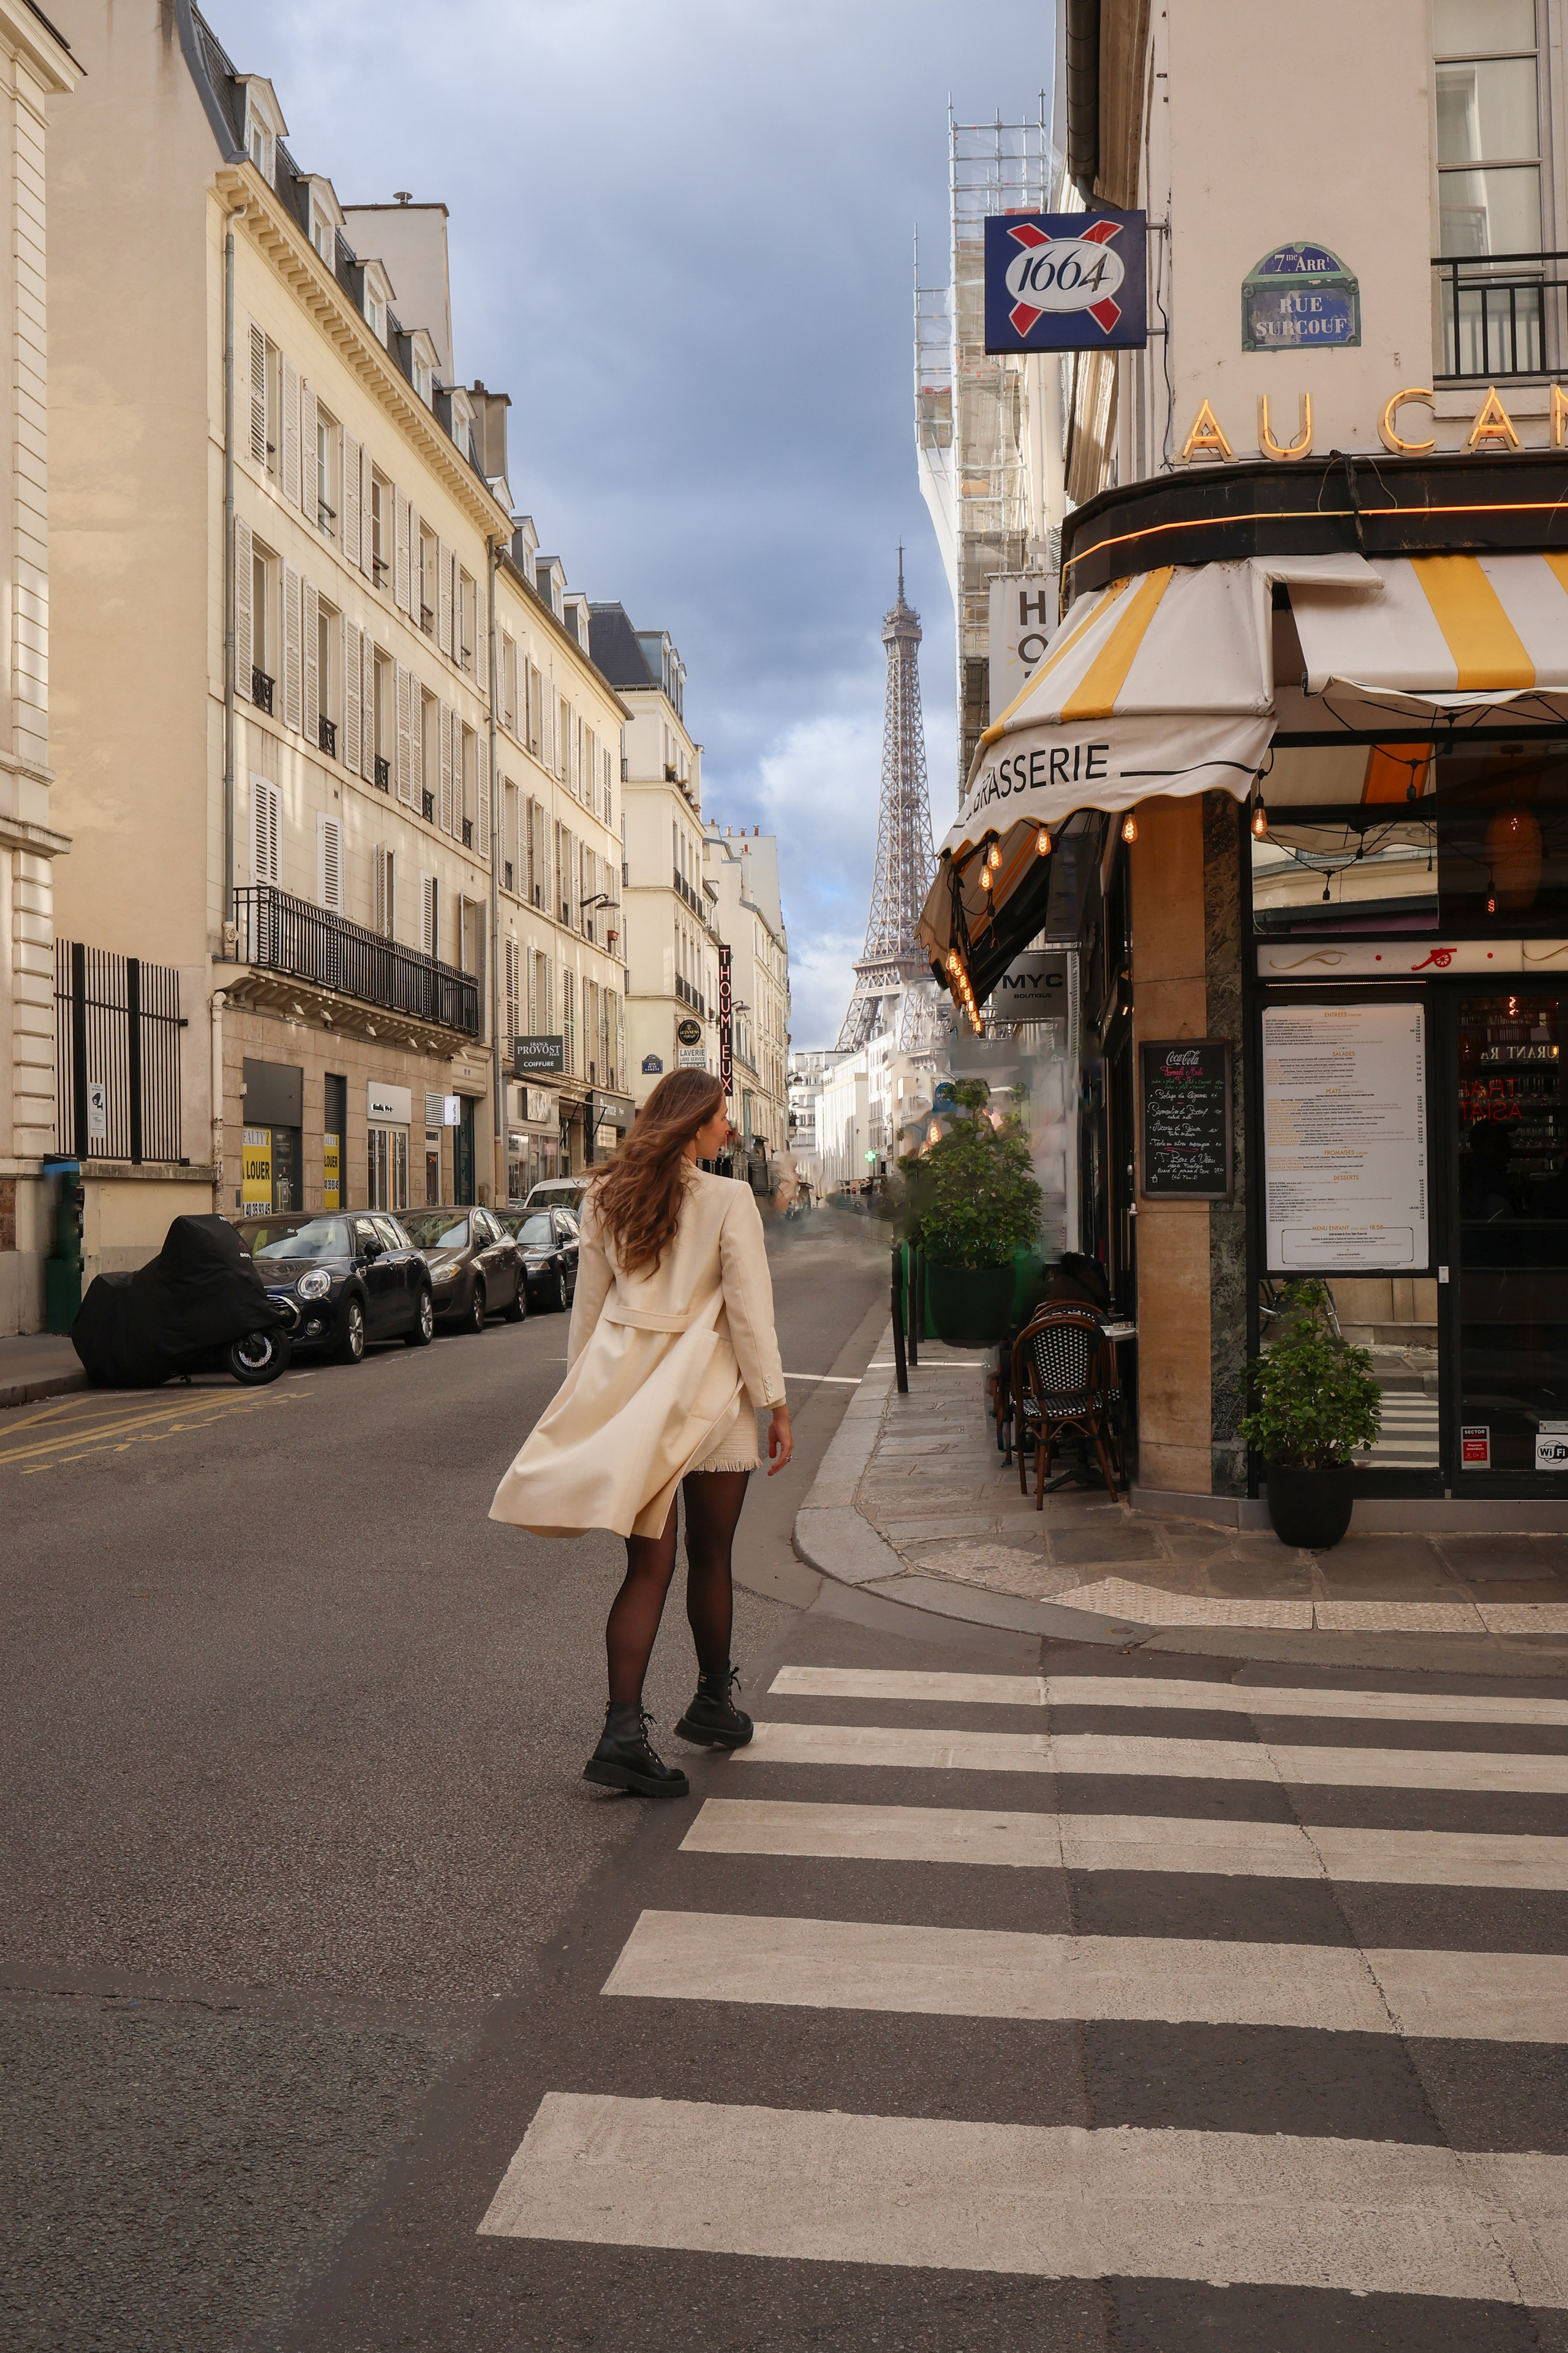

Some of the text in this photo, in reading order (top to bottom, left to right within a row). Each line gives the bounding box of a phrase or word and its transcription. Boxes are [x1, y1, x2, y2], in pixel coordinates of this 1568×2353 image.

[1017, 249, 1110, 293] 1664
[1280, 297, 1322, 313] RUE
[1256, 318, 1347, 336] SURCOUF
[1174, 392, 1314, 466] AU
[1018, 590, 1050, 678] HO
[973, 745, 1109, 814] BRASSERIE
[1002, 973, 1063, 989] MYC
[720, 949, 732, 1092] THOUMIEUX
[517, 1045, 560, 1054] PROVOST
[247, 1160, 270, 1180] LOUER
[325, 1155, 338, 1168] LOUER
[246, 1204, 252, 1217] 40
[252, 1203, 258, 1215] 35
[258, 1203, 264, 1215] 93
[265, 1203, 271, 1215] 45
